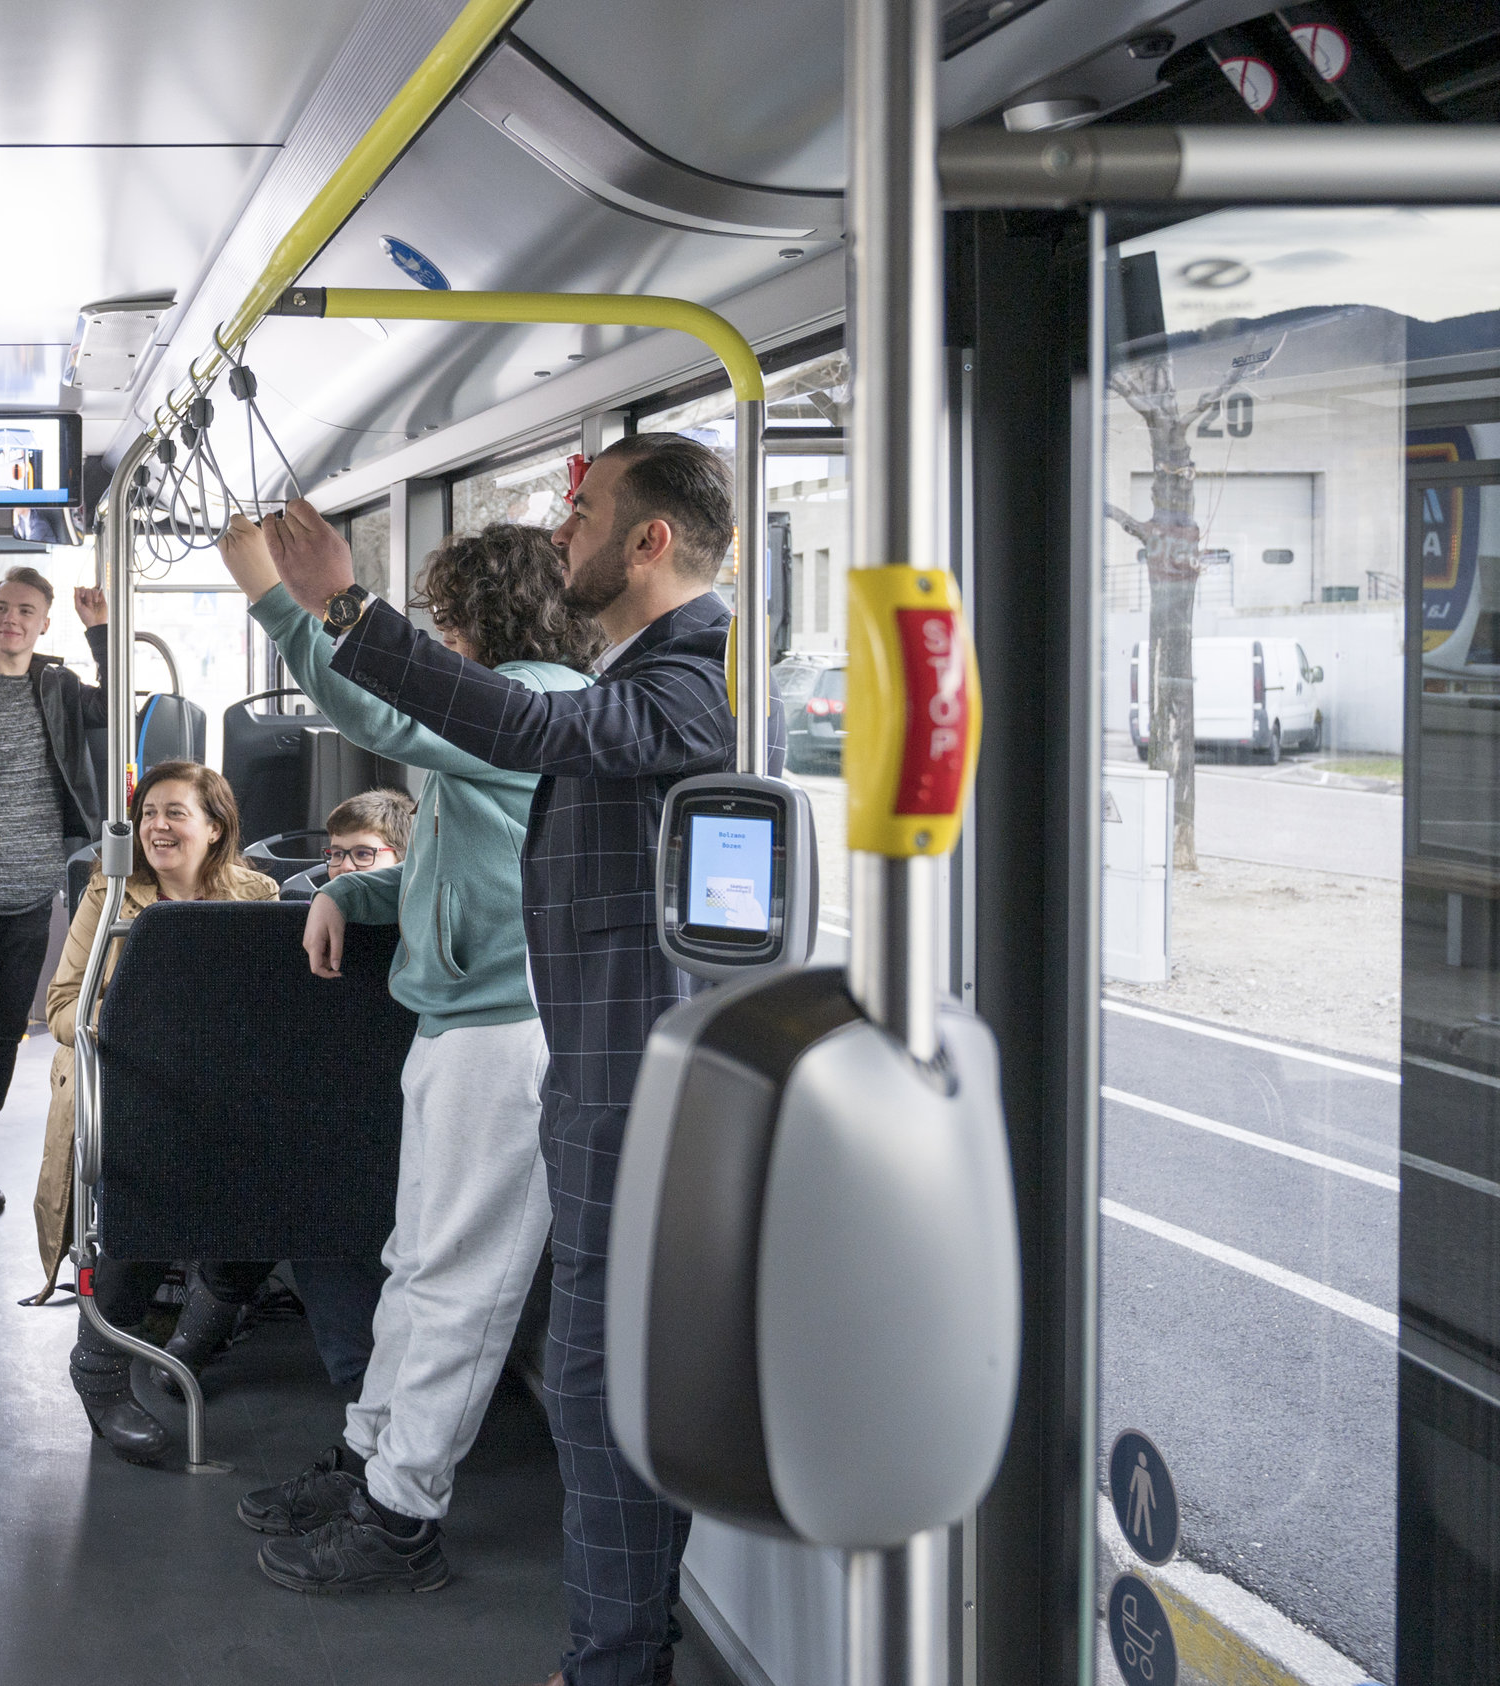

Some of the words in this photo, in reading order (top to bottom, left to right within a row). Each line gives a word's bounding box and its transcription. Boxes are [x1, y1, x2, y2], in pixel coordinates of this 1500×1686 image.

[1196, 392, 1254, 438] 20
[923, 618, 961, 762] STOP
[718, 831, 746, 839] Bolzano
